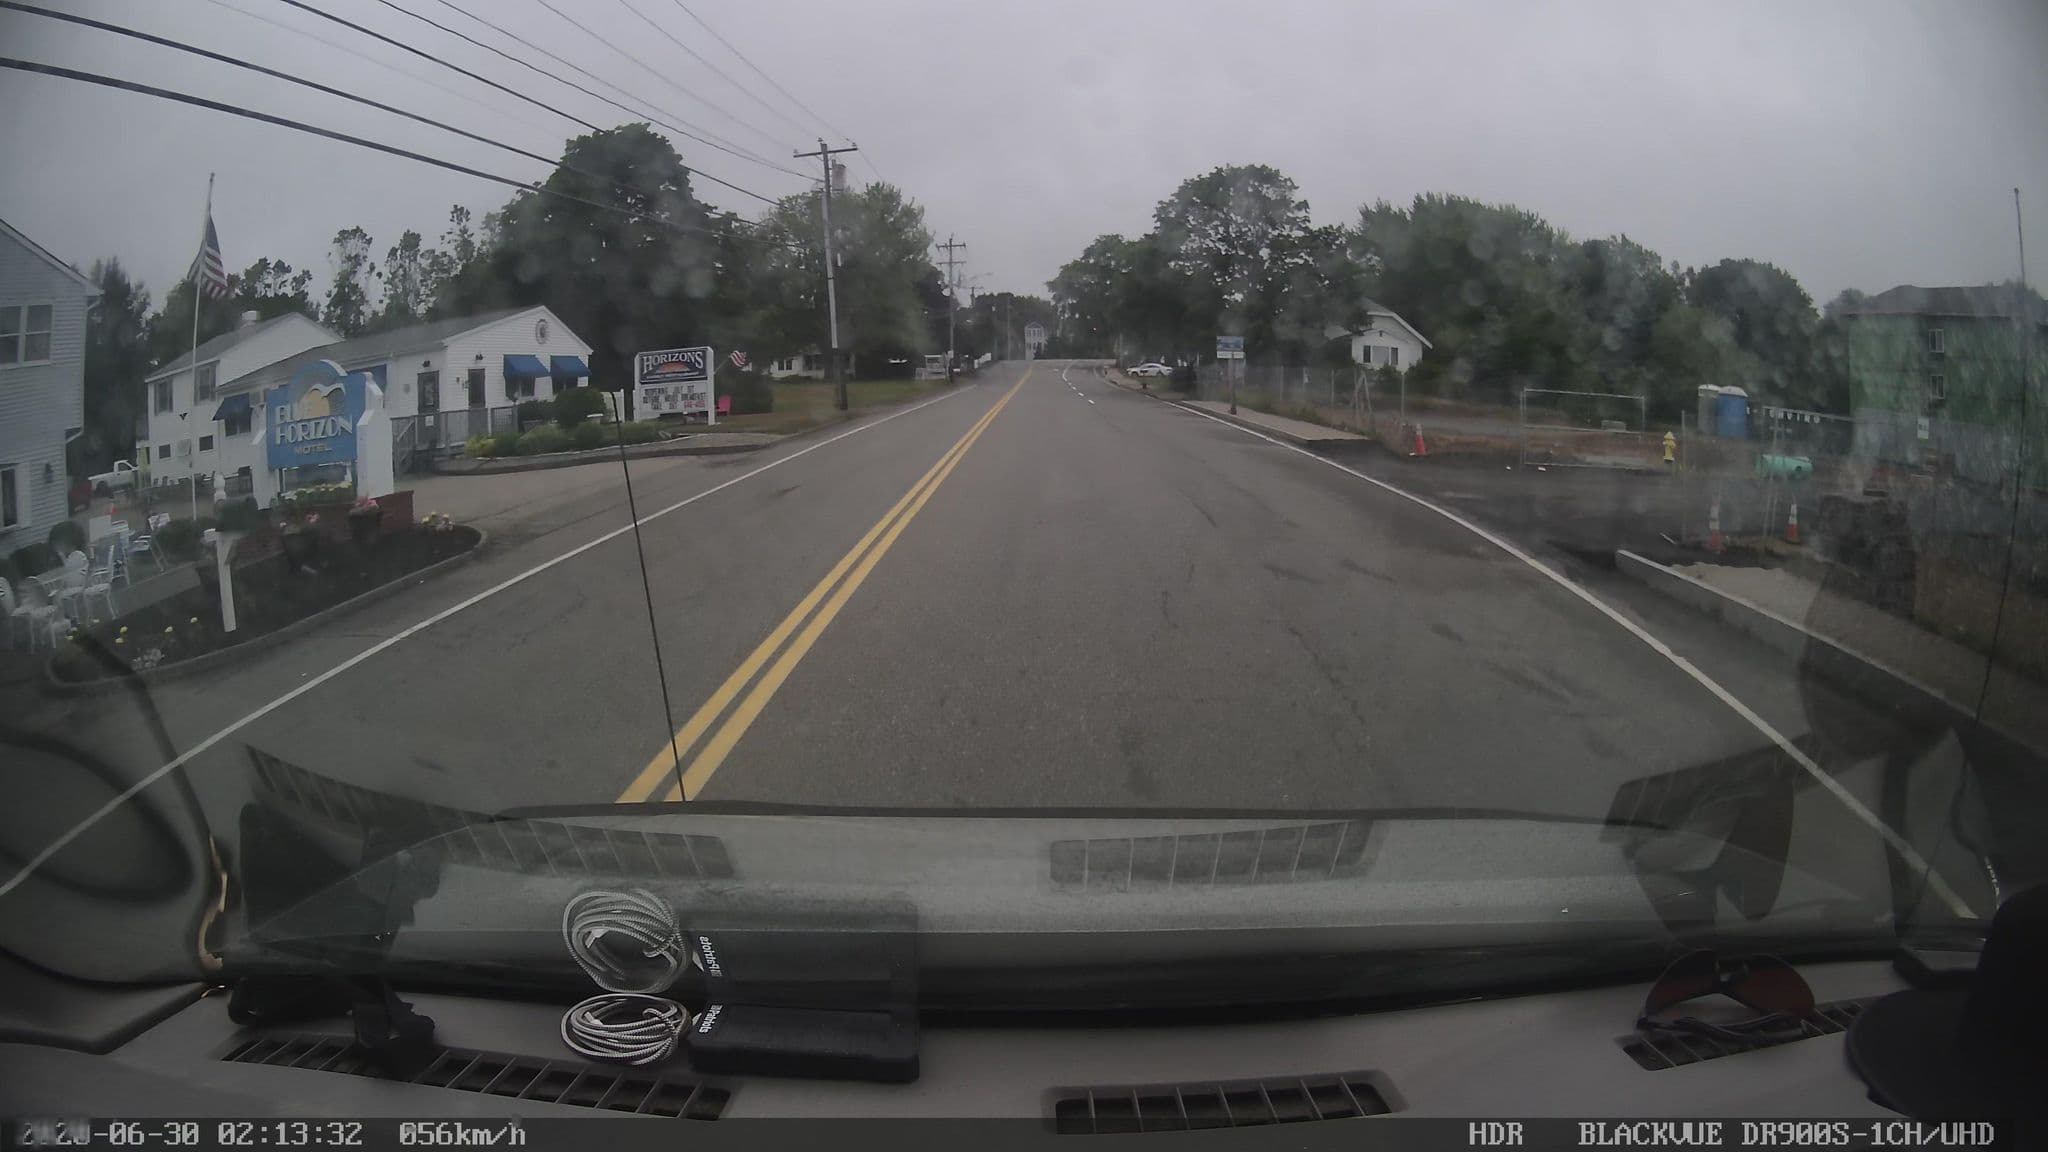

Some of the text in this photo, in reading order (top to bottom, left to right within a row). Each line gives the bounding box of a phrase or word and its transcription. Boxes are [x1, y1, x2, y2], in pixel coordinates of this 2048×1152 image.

[643, 352, 704, 374] HORIZONS
[276, 414, 353, 446] HORIZON
[297, 443, 333, 456] MOTEL
